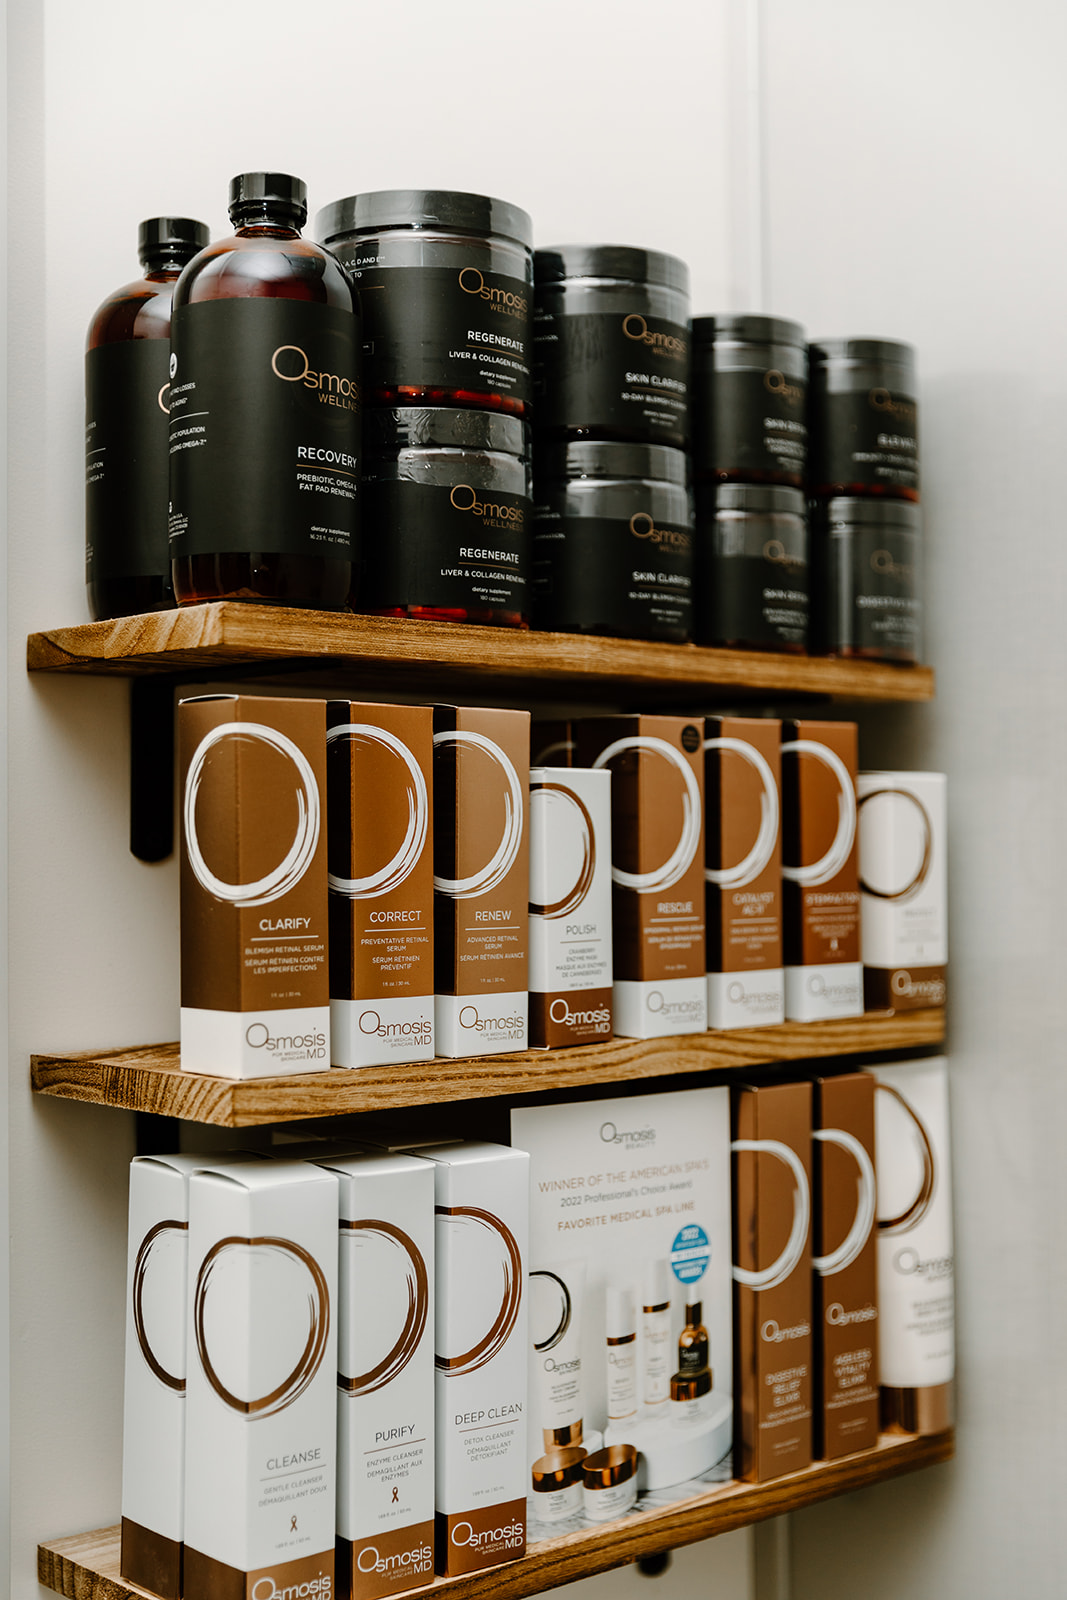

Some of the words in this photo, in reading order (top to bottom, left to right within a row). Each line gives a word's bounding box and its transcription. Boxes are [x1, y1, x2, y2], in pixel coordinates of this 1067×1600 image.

[468, 330, 524, 353] REGENERATE
[449, 351, 471, 360] LIVER
[479, 354, 511, 367] COLLAGEN
[625, 372, 649, 384] SKIN
[297, 446, 357, 468] RECOVERY
[297, 474, 335, 486] PREBIOTIC,
[336, 480, 354, 489] OMEGA
[316, 485, 329, 494] PAD
[450, 484, 524, 522] Osmosis
[460, 547, 520, 564] REGENERATE
[441, 569, 463, 577] LIVER
[471, 570, 505, 581] COLLAGEN
[632, 570, 656, 582] SKIN
[657, 902, 693, 913] RESCUE
[370, 910, 422, 923] CORRECT
[475, 910, 512, 921] RENEW
[259, 917, 311, 931] CLARIFY
[566, 924, 597, 935] POLISH
[361, 937, 404, 945] PREVENTATIVE
[245, 947, 274, 955] BLEMISH
[303, 944, 325, 952] SERUM
[300, 955, 325, 963] CONTRE
[253, 967, 266, 975] LES
[267, 963, 318, 974] IMPERFECTIONS
[459, 1006, 524, 1031] Osmosis
[550, 999, 610, 1026] Osmosis
[359, 1010, 432, 1037] Osmosis
[595, 1022, 610, 1033] MD
[246, 1022, 326, 1051] Osmosis
[414, 1035, 432, 1046] MD
[508, 1029, 525, 1040] MD
[307, 1047, 326, 1060] MD
[600, 1122, 656, 1144] Osmosis
[538, 1176, 585, 1192] WINNER
[588, 1174, 603, 1187] OF
[606, 1171, 627, 1183] THE
[629, 1165, 682, 1181] AMERICAN
[560, 1198, 582, 1207] 2022
[584, 1188, 639, 1202] Professional's
[640, 1184, 667, 1196] Choice
[669, 1180, 693, 1190] Award
[558, 1215, 608, 1231] FAVORITE
[610, 1209, 652, 1224] MEDICAL
[656, 1205, 673, 1216] SPA
[675, 1202, 696, 1212] LINE
[455, 1411, 485, 1425] DEEP
[488, 1403, 523, 1420] CLEAN
[375, 1424, 416, 1443] PURIFY
[464, 1438, 485, 1446] DETOX
[485, 1430, 514, 1442] CLEANSER
[266, 1448, 321, 1470] CLEANSE
[367, 1456, 391, 1468] ENZYME
[393, 1449, 424, 1461] CLEANSER
[410, 1460, 423, 1468] AUX
[381, 1470, 409, 1482] ENZYMES
[264, 1483, 289, 1495] GENTLE
[291, 1475, 323, 1489] CLEANSER
[310, 1485, 328, 1495] DOUX
[451, 1518, 523, 1547] Osmosis
[505, 1536, 523, 1549] MD
[358, 1541, 432, 1573] Osmosis
[414, 1560, 432, 1574] MD
[252, 1571, 331, 1600] Osmosis
